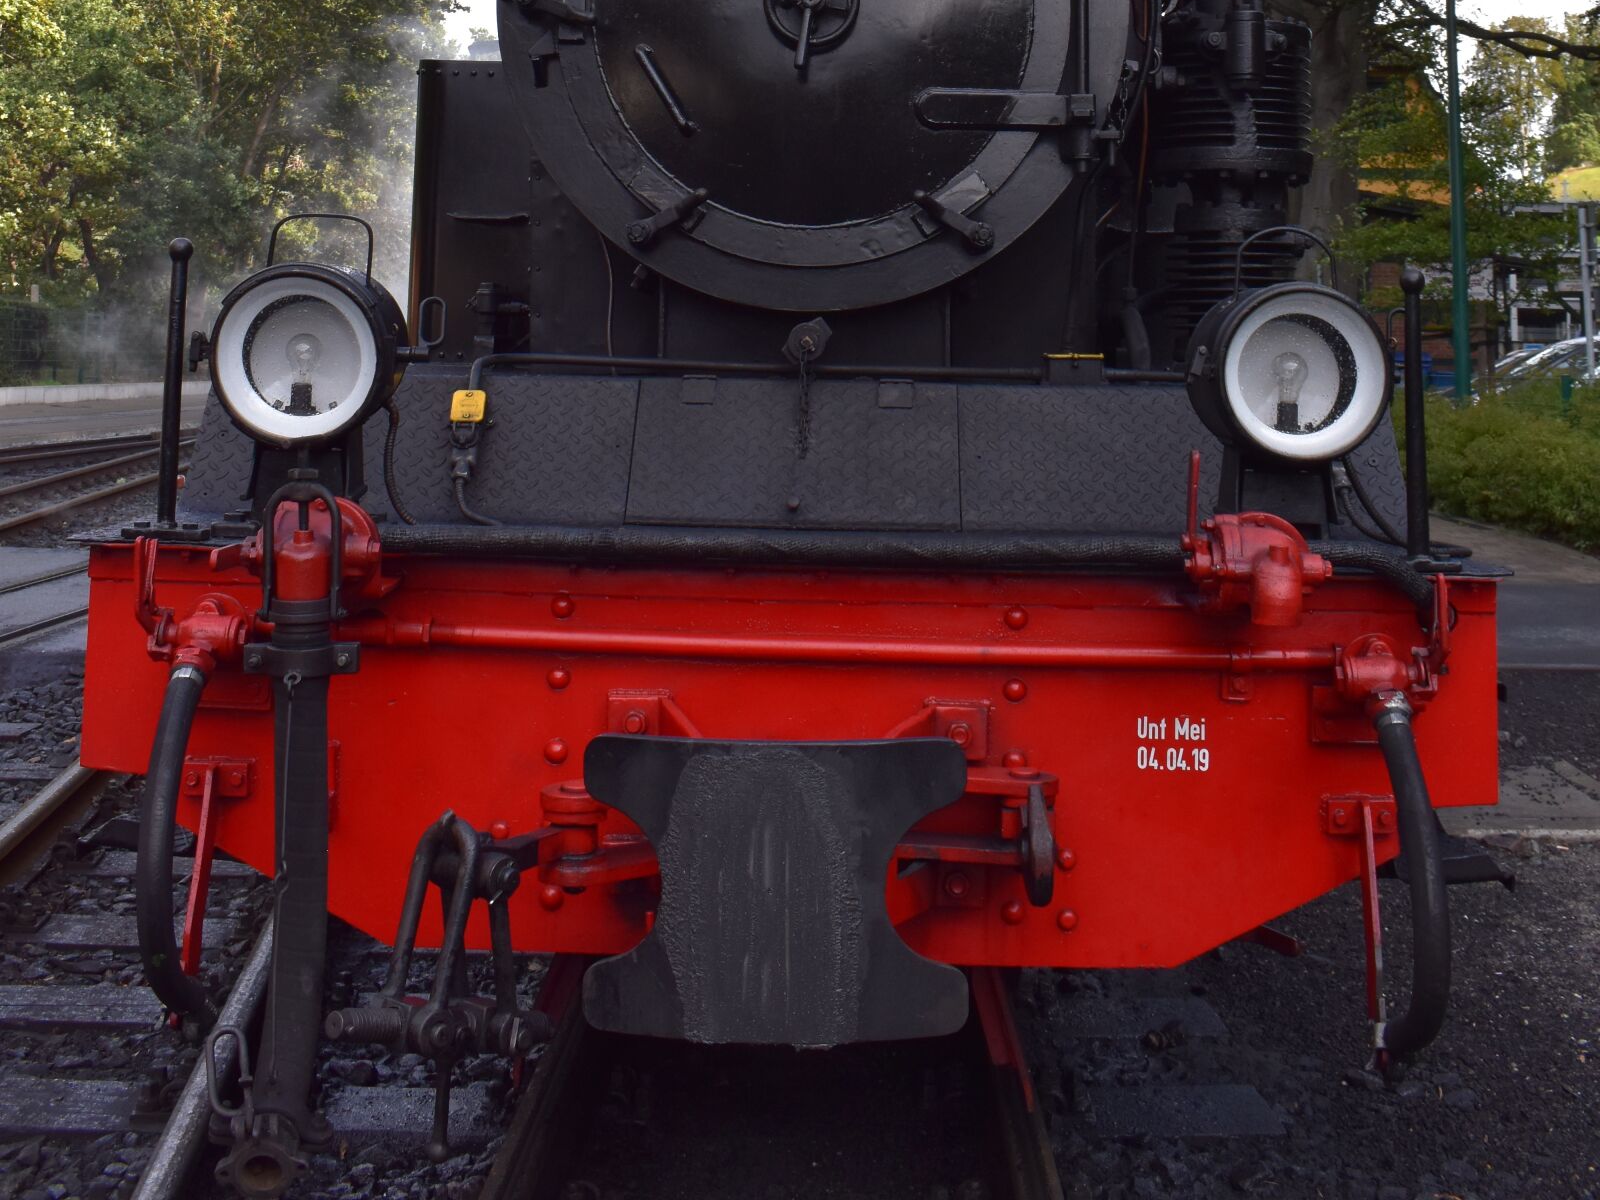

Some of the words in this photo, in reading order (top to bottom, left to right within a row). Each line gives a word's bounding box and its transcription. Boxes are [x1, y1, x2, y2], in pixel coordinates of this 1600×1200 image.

[1137, 716, 1167, 740] Unt
[1174, 717, 1206, 741] Mei
[1137, 746, 1210, 772] 04.04.19
